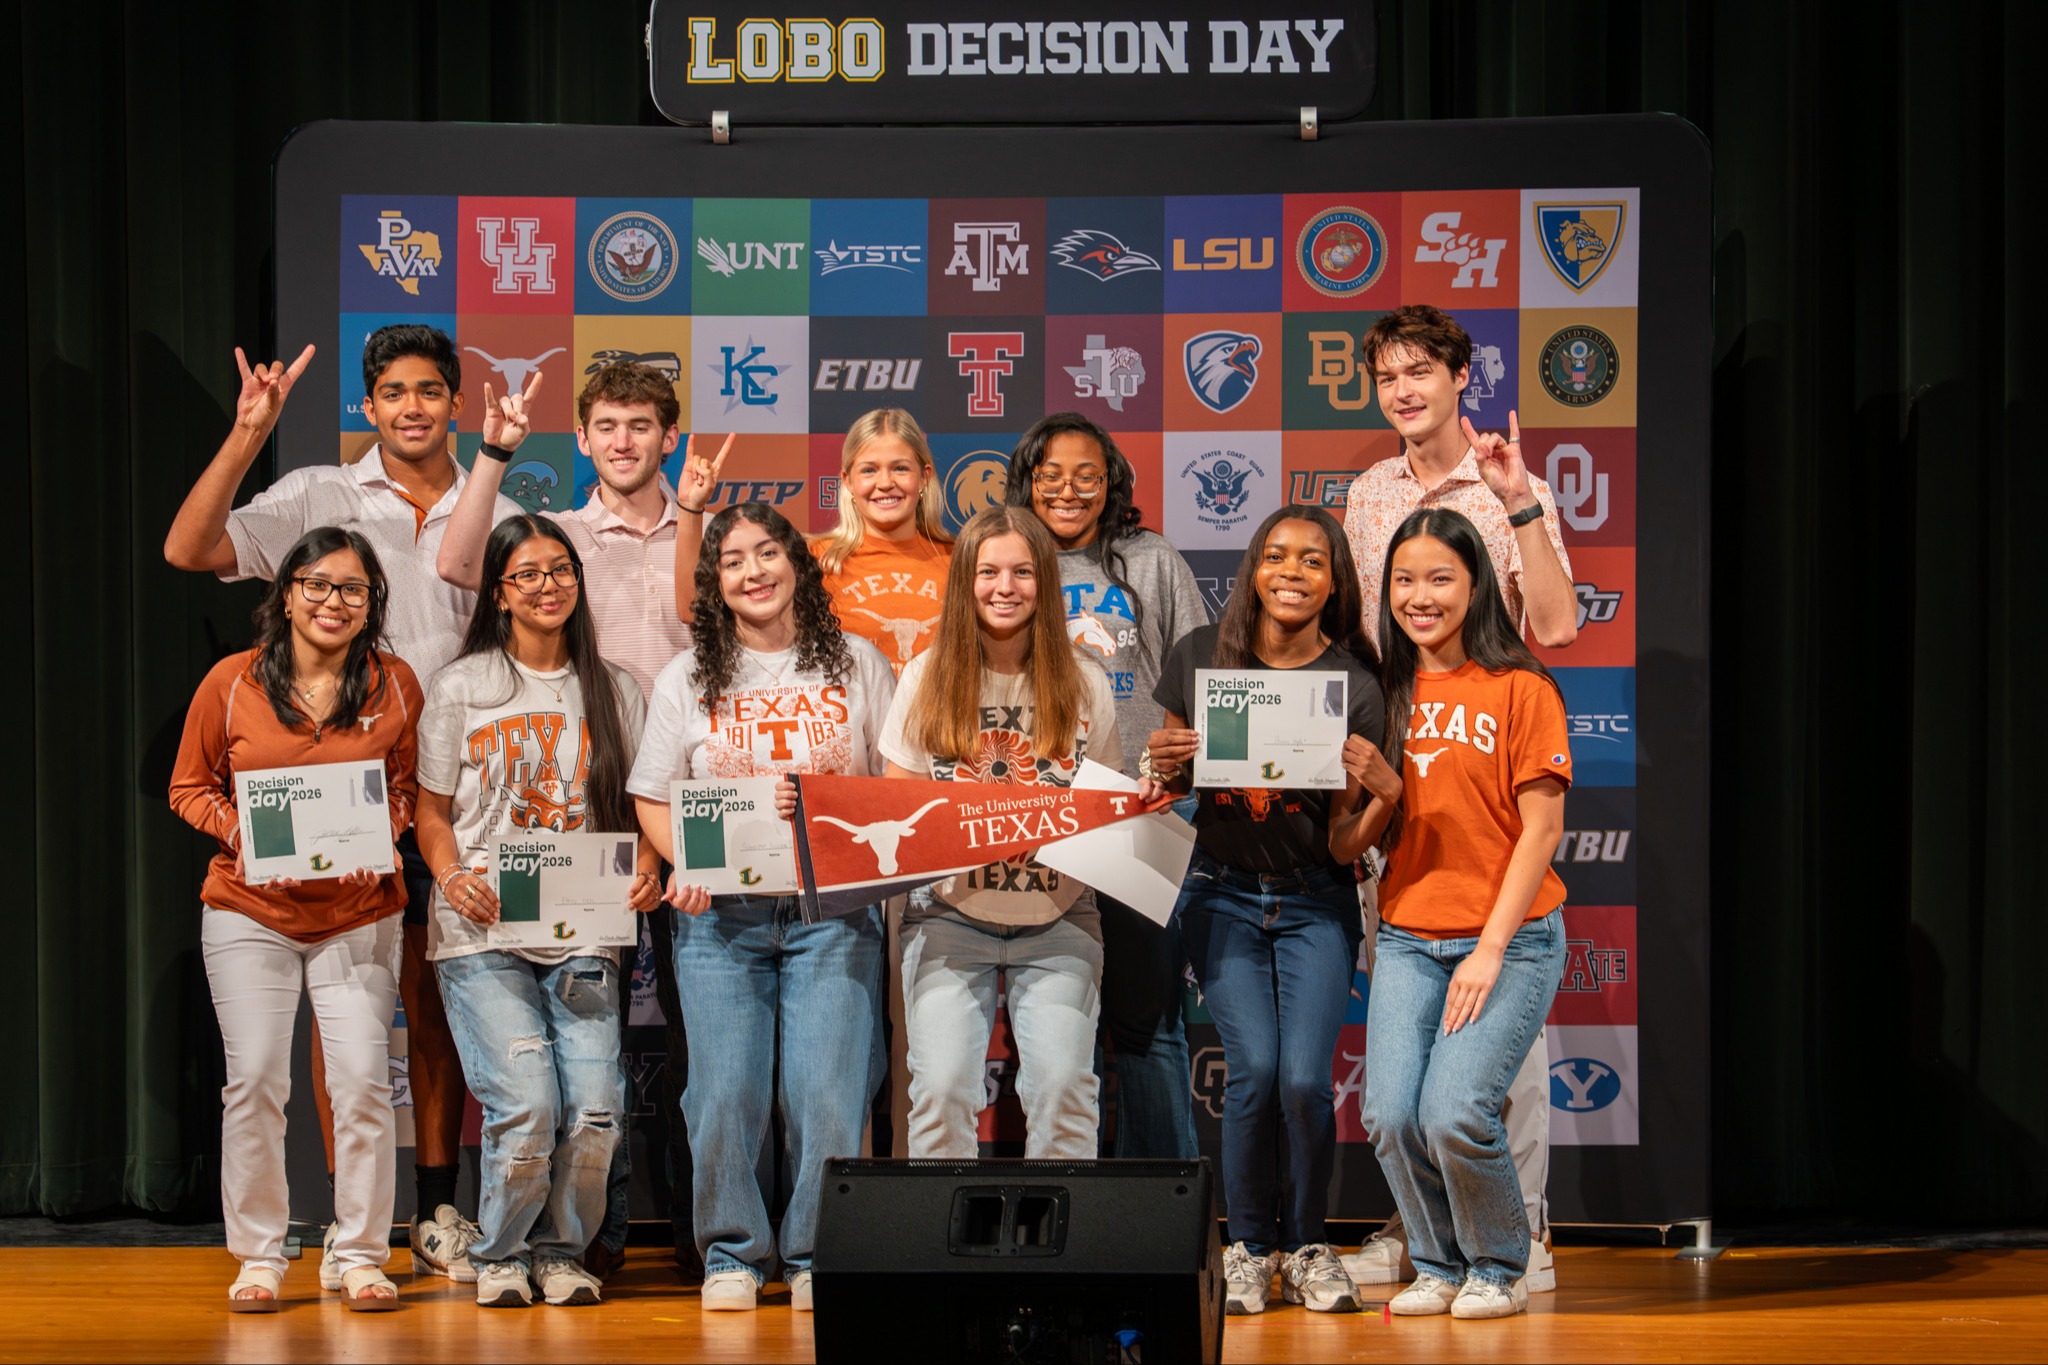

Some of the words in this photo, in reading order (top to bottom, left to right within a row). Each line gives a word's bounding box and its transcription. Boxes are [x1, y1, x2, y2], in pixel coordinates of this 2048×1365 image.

[687, 17, 885, 83] LOBO
[907, 22, 1188, 76] DECISION
[1208, 19, 1344, 73] DAY
[1312, 214, 1341, 233] UNITED
[1343, 213, 1371, 231] STATES
[477, 217, 556, 294] UH
[727, 242, 805, 270] UNT
[848, 245, 922, 263] TSTC
[1173, 237, 1274, 271] LSU
[1313, 272, 1343, 290] MARINE
[1346, 273, 1371, 289] CORPS
[720, 346, 779, 406] KC
[813, 358, 923, 391] ETBU
[1308, 331, 1370, 411] BU
[1566, 393, 1595, 404] ARMY
[1180, 459, 1198, 479] UNITED
[1200, 450, 1222, 461] STATES
[1226, 450, 1247, 461] COAST
[1248, 459, 1265, 478] GUARD
[1545, 443, 1609, 531] OU
[1197, 514, 1221, 525] SEMPER
[1221, 514, 1248, 525] PARATUS
[842, 571, 939, 604] TEXA
[1117, 628, 1138, 649] 95
[728, 691, 745, 700] THE
[749, 685, 805, 697] UNIVERSITY
[809, 683, 820, 693] OF
[1207, 678, 1265, 689] Decision
[698, 686, 849, 733] TEXAS
[1206, 690, 1249, 714] day
[1250, 694, 1282, 705] 2026
[757, 719, 799, 761] T
[248, 775, 304, 790] Decision
[682, 786, 738, 800] Decision
[248, 790, 290, 812] day
[291, 788, 322, 801] 2026
[681, 800, 723, 823] day
[724, 800, 755, 812] 2026
[957, 803, 984, 817] The
[986, 793, 1058, 814] University
[1060, 790, 1075, 804] of
[1109, 796, 1129, 816] T
[960, 806, 1080, 849] TEXAS
[499, 841, 556, 853] Decision
[498, 854, 541, 877] day
[541, 856, 573, 867] 2026
[1550, 1061, 1611, 1109] Y
